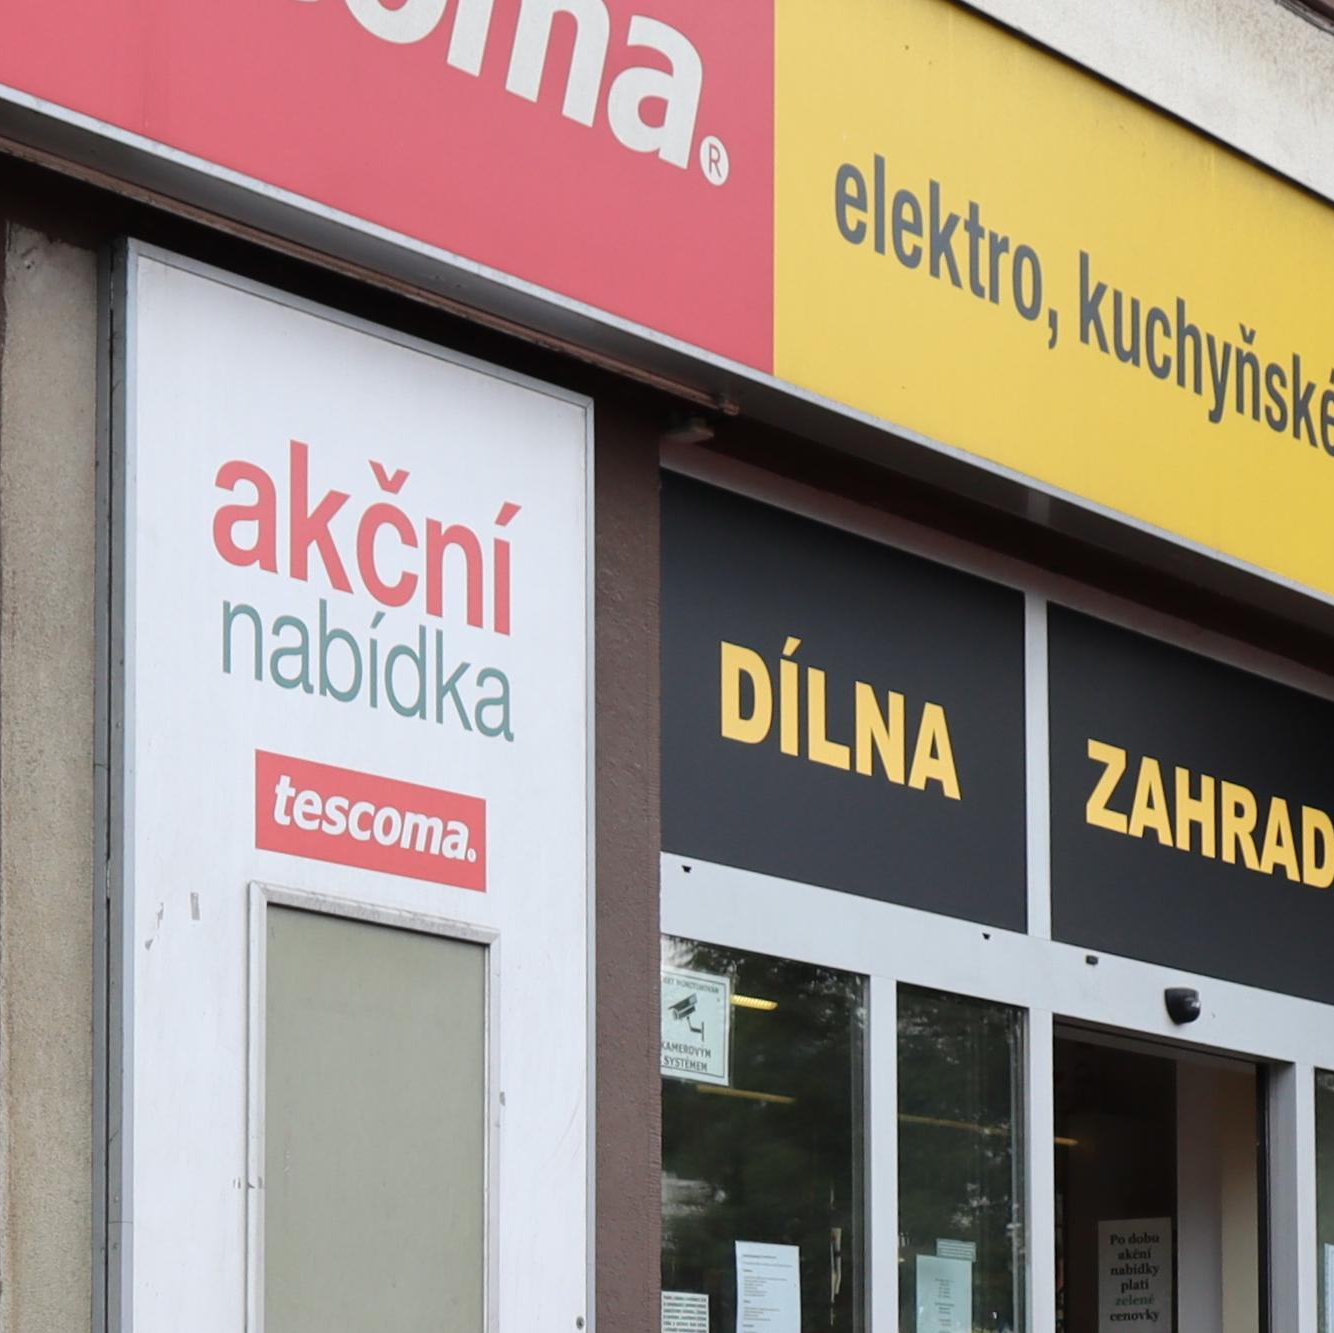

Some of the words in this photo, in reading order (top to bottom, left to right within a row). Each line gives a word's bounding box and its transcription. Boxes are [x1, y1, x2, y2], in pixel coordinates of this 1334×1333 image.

[834, 154, 1058, 349] elektro,
[212, 439, 522, 636] akční
[221, 598, 515, 743] nabídka
[720, 636, 962, 801] DÍLNA
